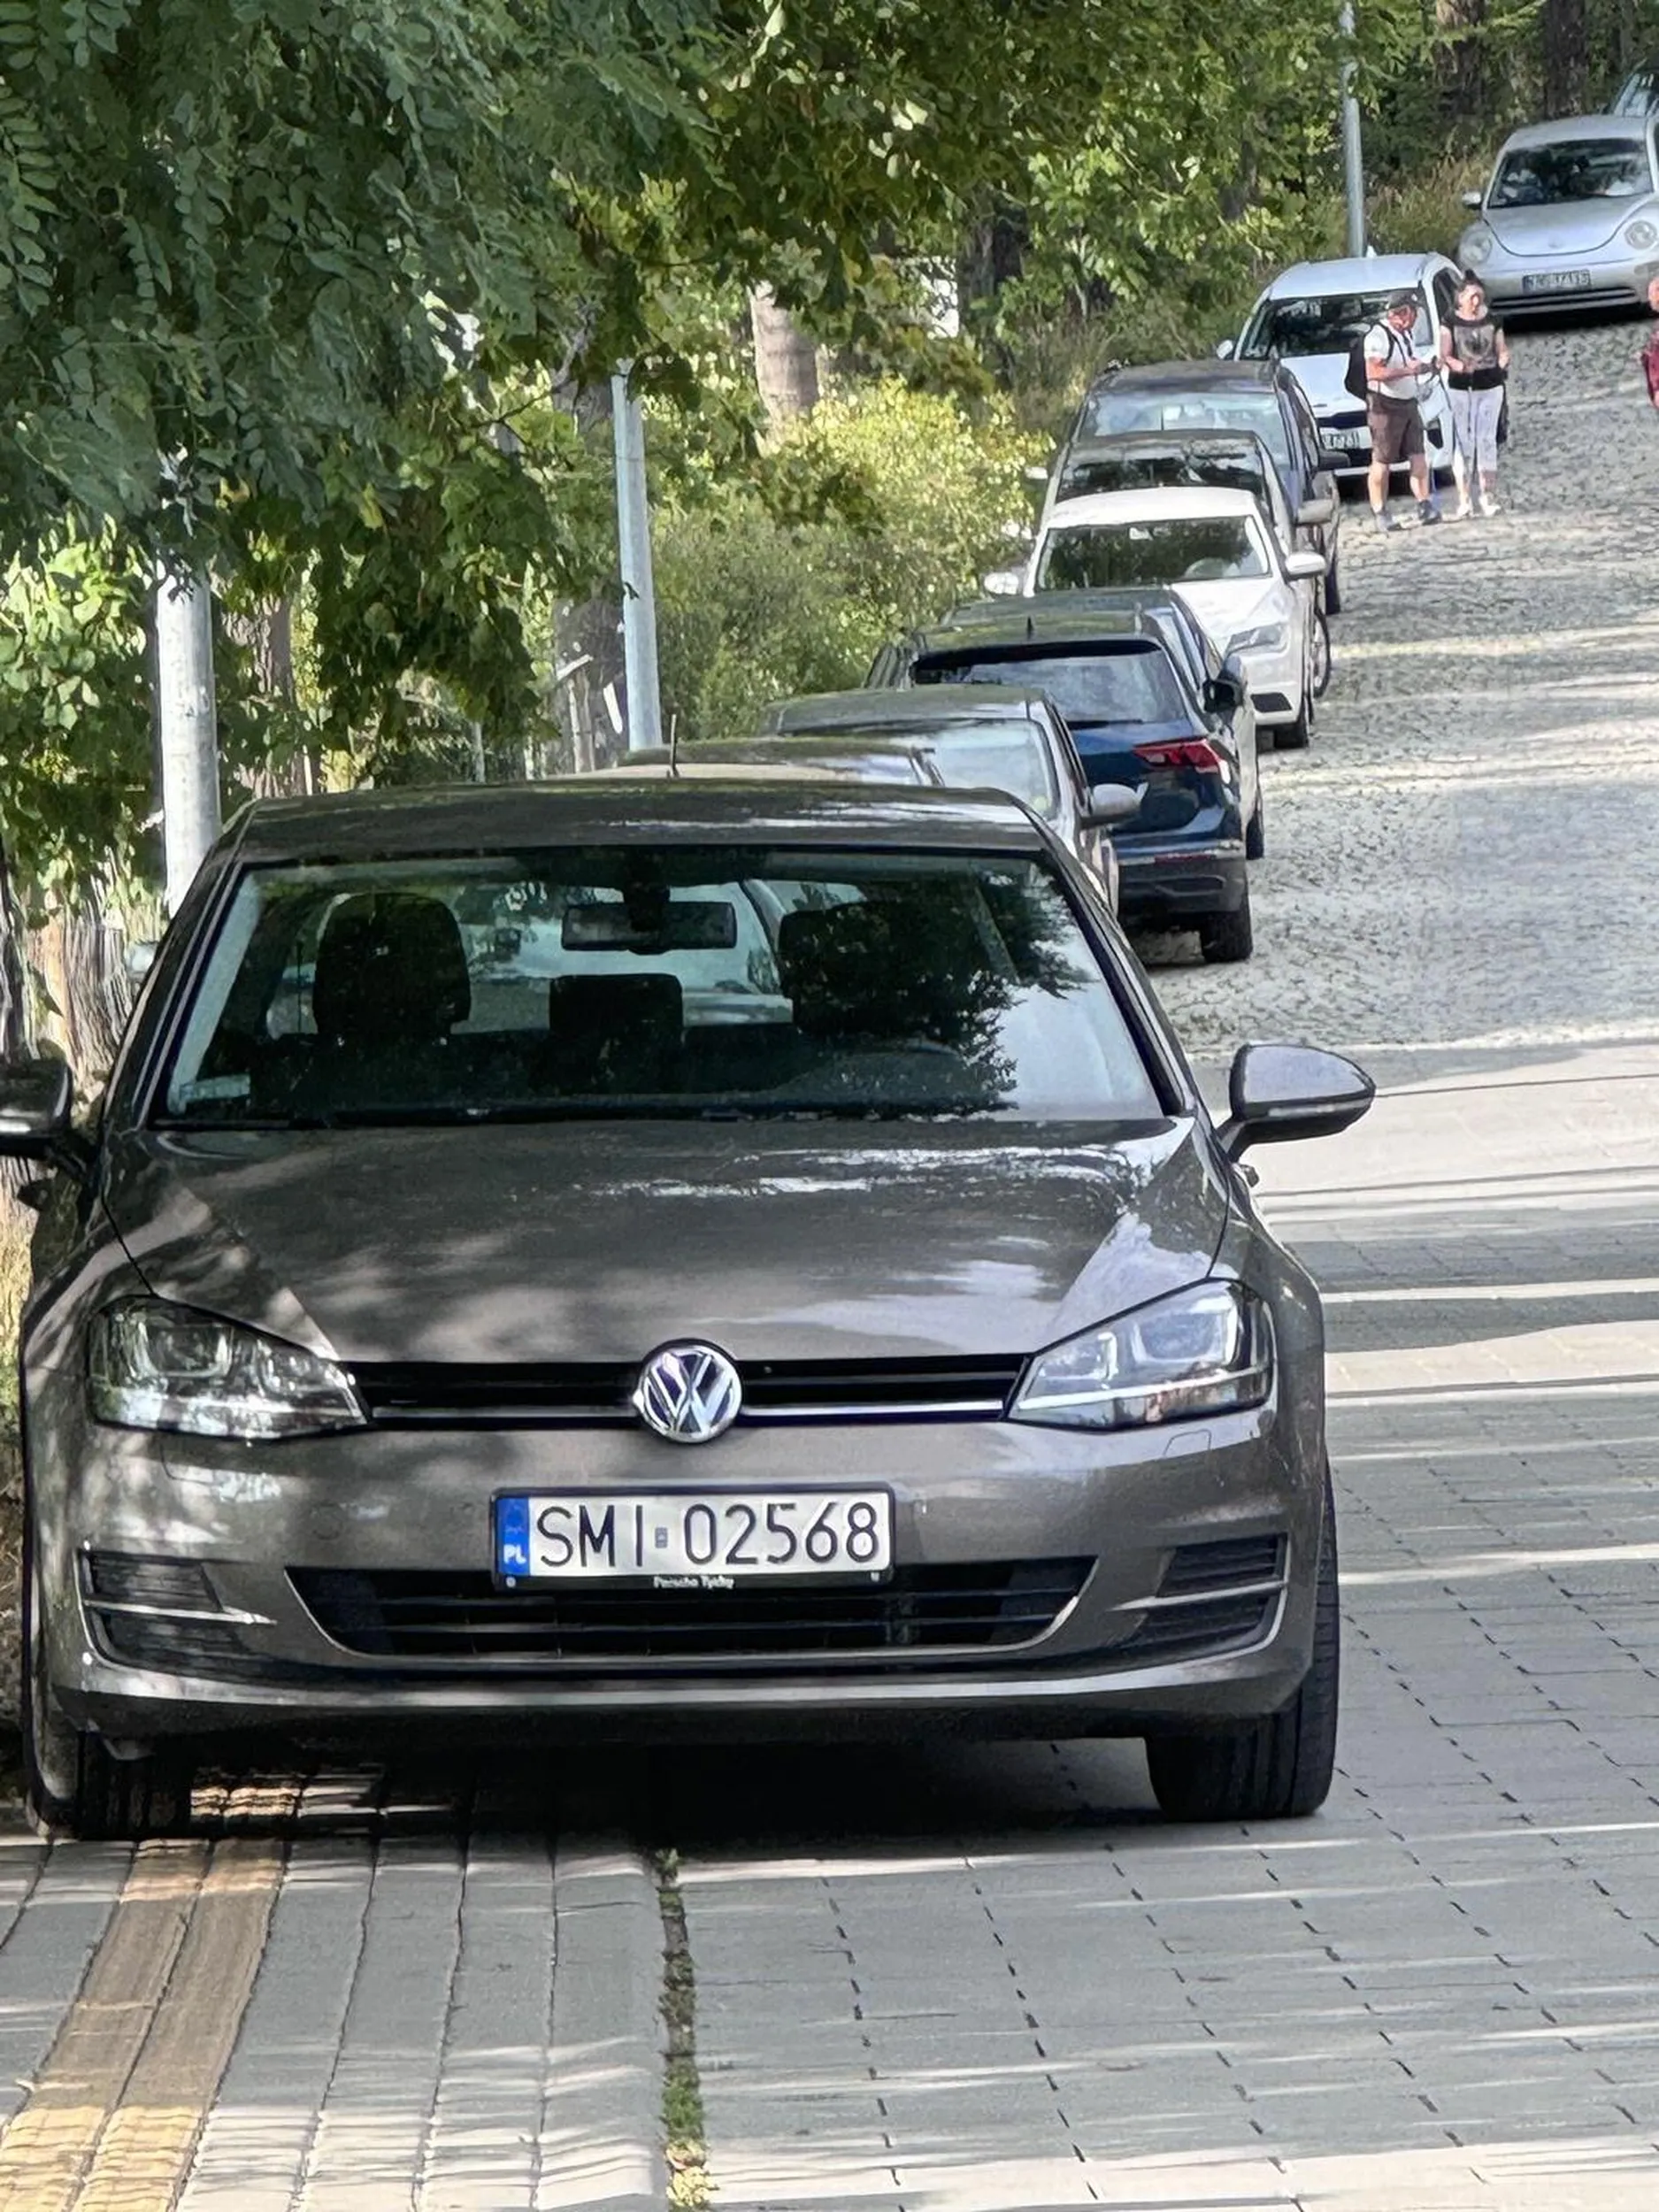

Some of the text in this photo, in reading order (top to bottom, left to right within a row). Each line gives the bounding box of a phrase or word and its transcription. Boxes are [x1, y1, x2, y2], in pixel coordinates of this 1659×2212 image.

[644, 1349, 737, 1438] VW
[503, 1544, 527, 1565] PL
[536, 1502, 880, 1567] SMI 02568
